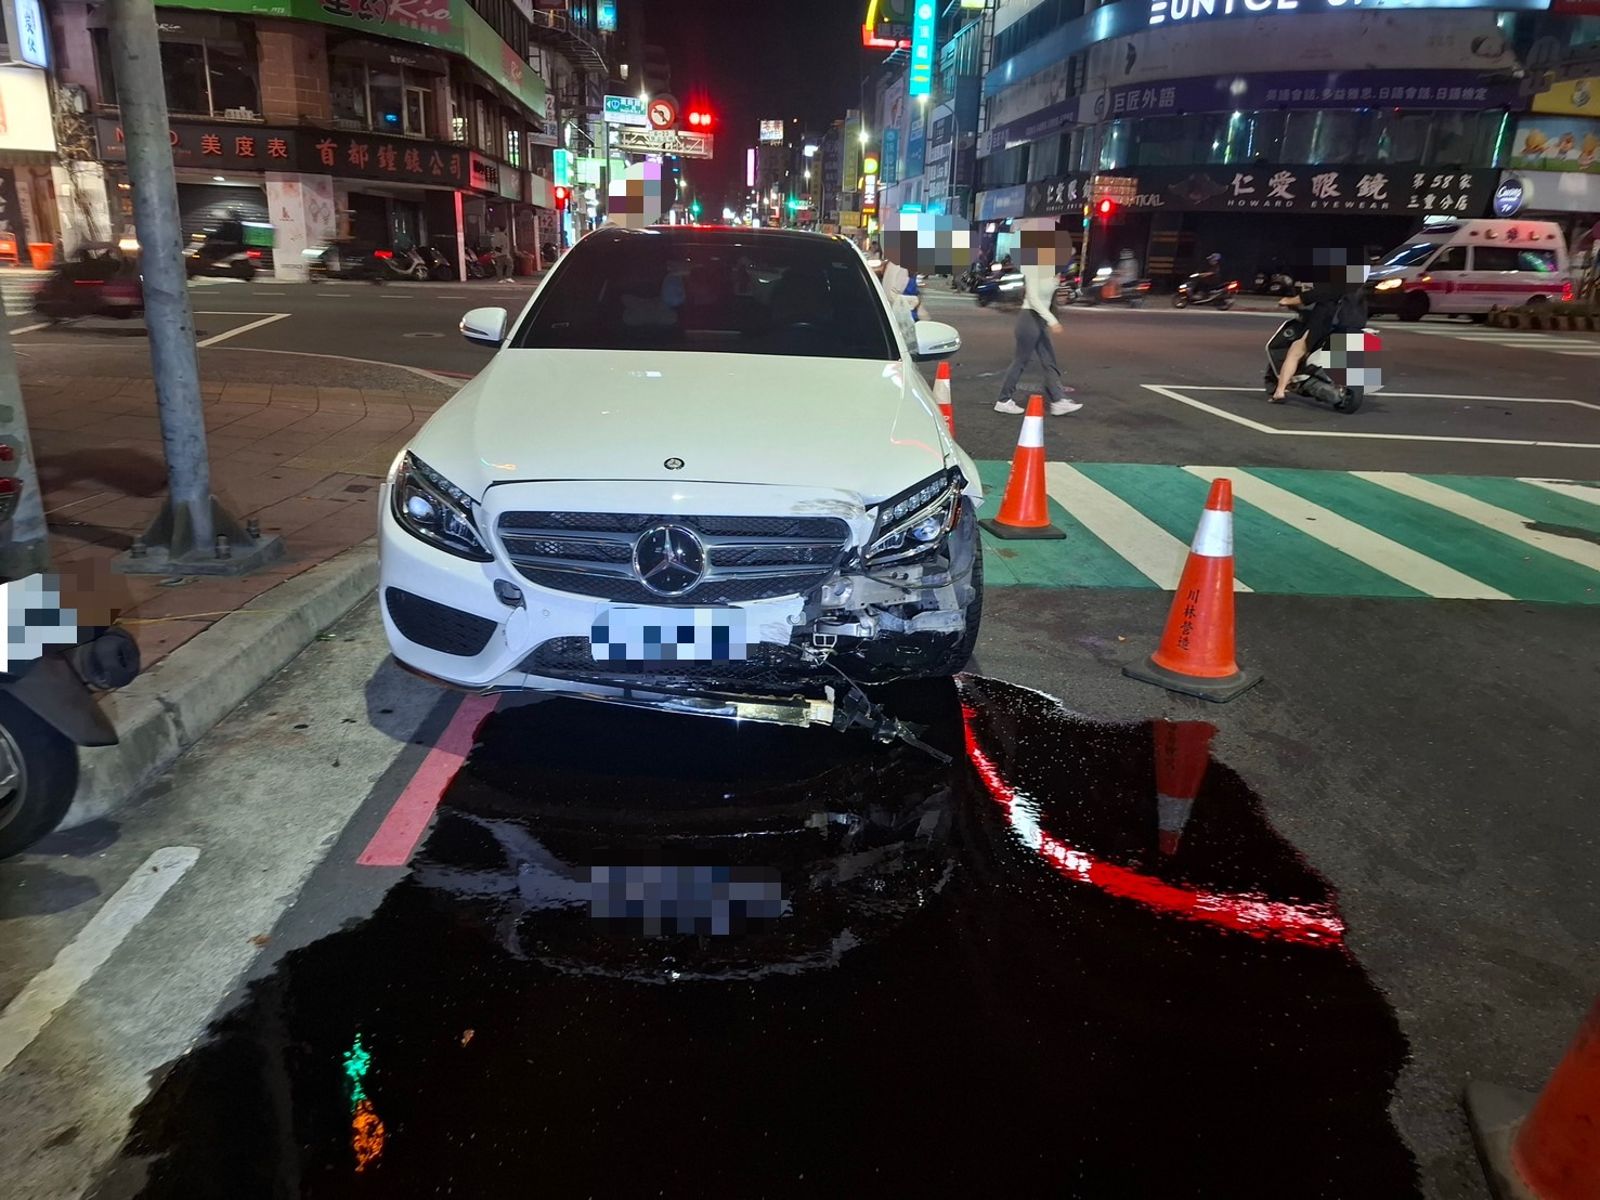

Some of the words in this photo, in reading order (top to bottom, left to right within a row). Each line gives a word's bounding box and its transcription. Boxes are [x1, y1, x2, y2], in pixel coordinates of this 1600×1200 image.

[1112, 87, 1176, 113] 巨匠外語
[201, 134, 288, 158] 美度表
[1231, 170, 1389, 200] 仁愛眼鏡
[1226, 200, 1295, 208] HOWARD
[1309, 200, 1390, 210] EYEWEAR
[1406, 193, 1469, 211] 三重分店
[1177, 588, 1200, 651] 川林營造
